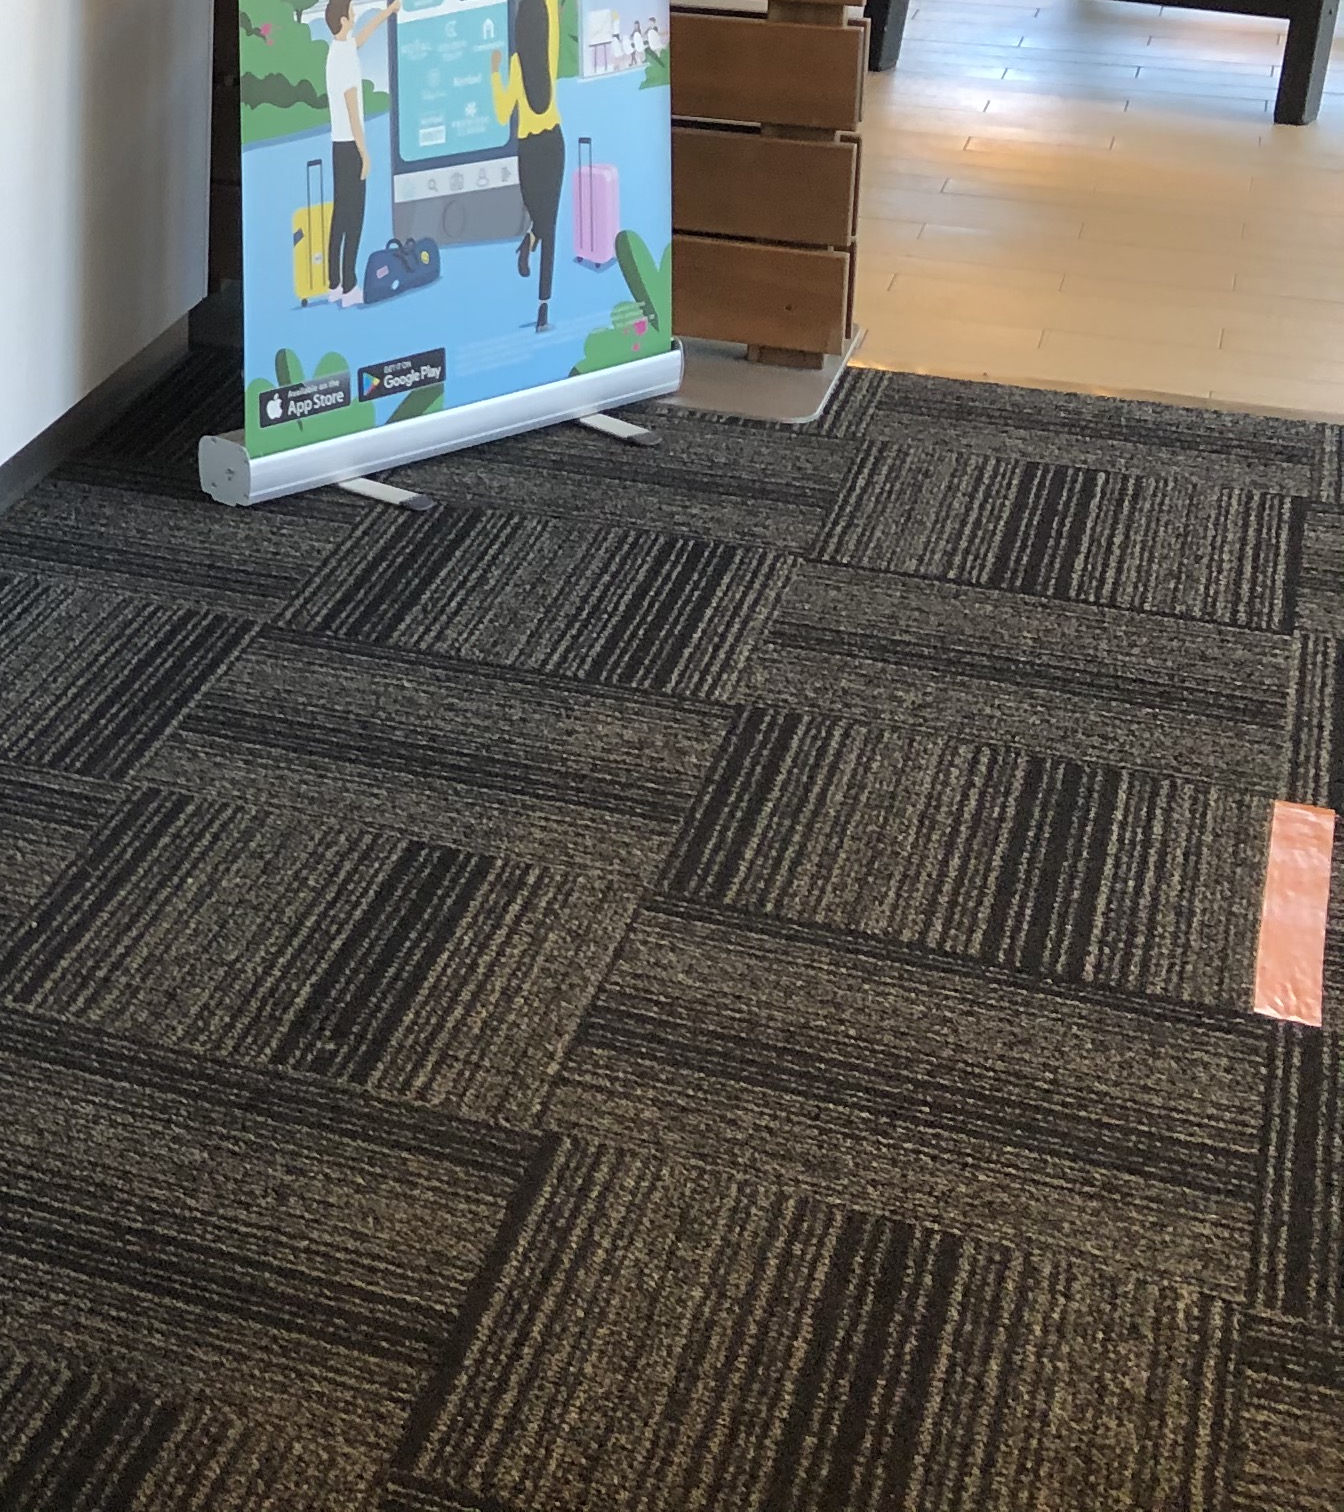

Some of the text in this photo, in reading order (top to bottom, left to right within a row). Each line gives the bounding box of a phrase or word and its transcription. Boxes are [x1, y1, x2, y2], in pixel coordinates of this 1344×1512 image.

[384, 364, 442, 389] Google Play
[287, 383, 318, 398] Available
[287, 390, 345, 416] App Store
